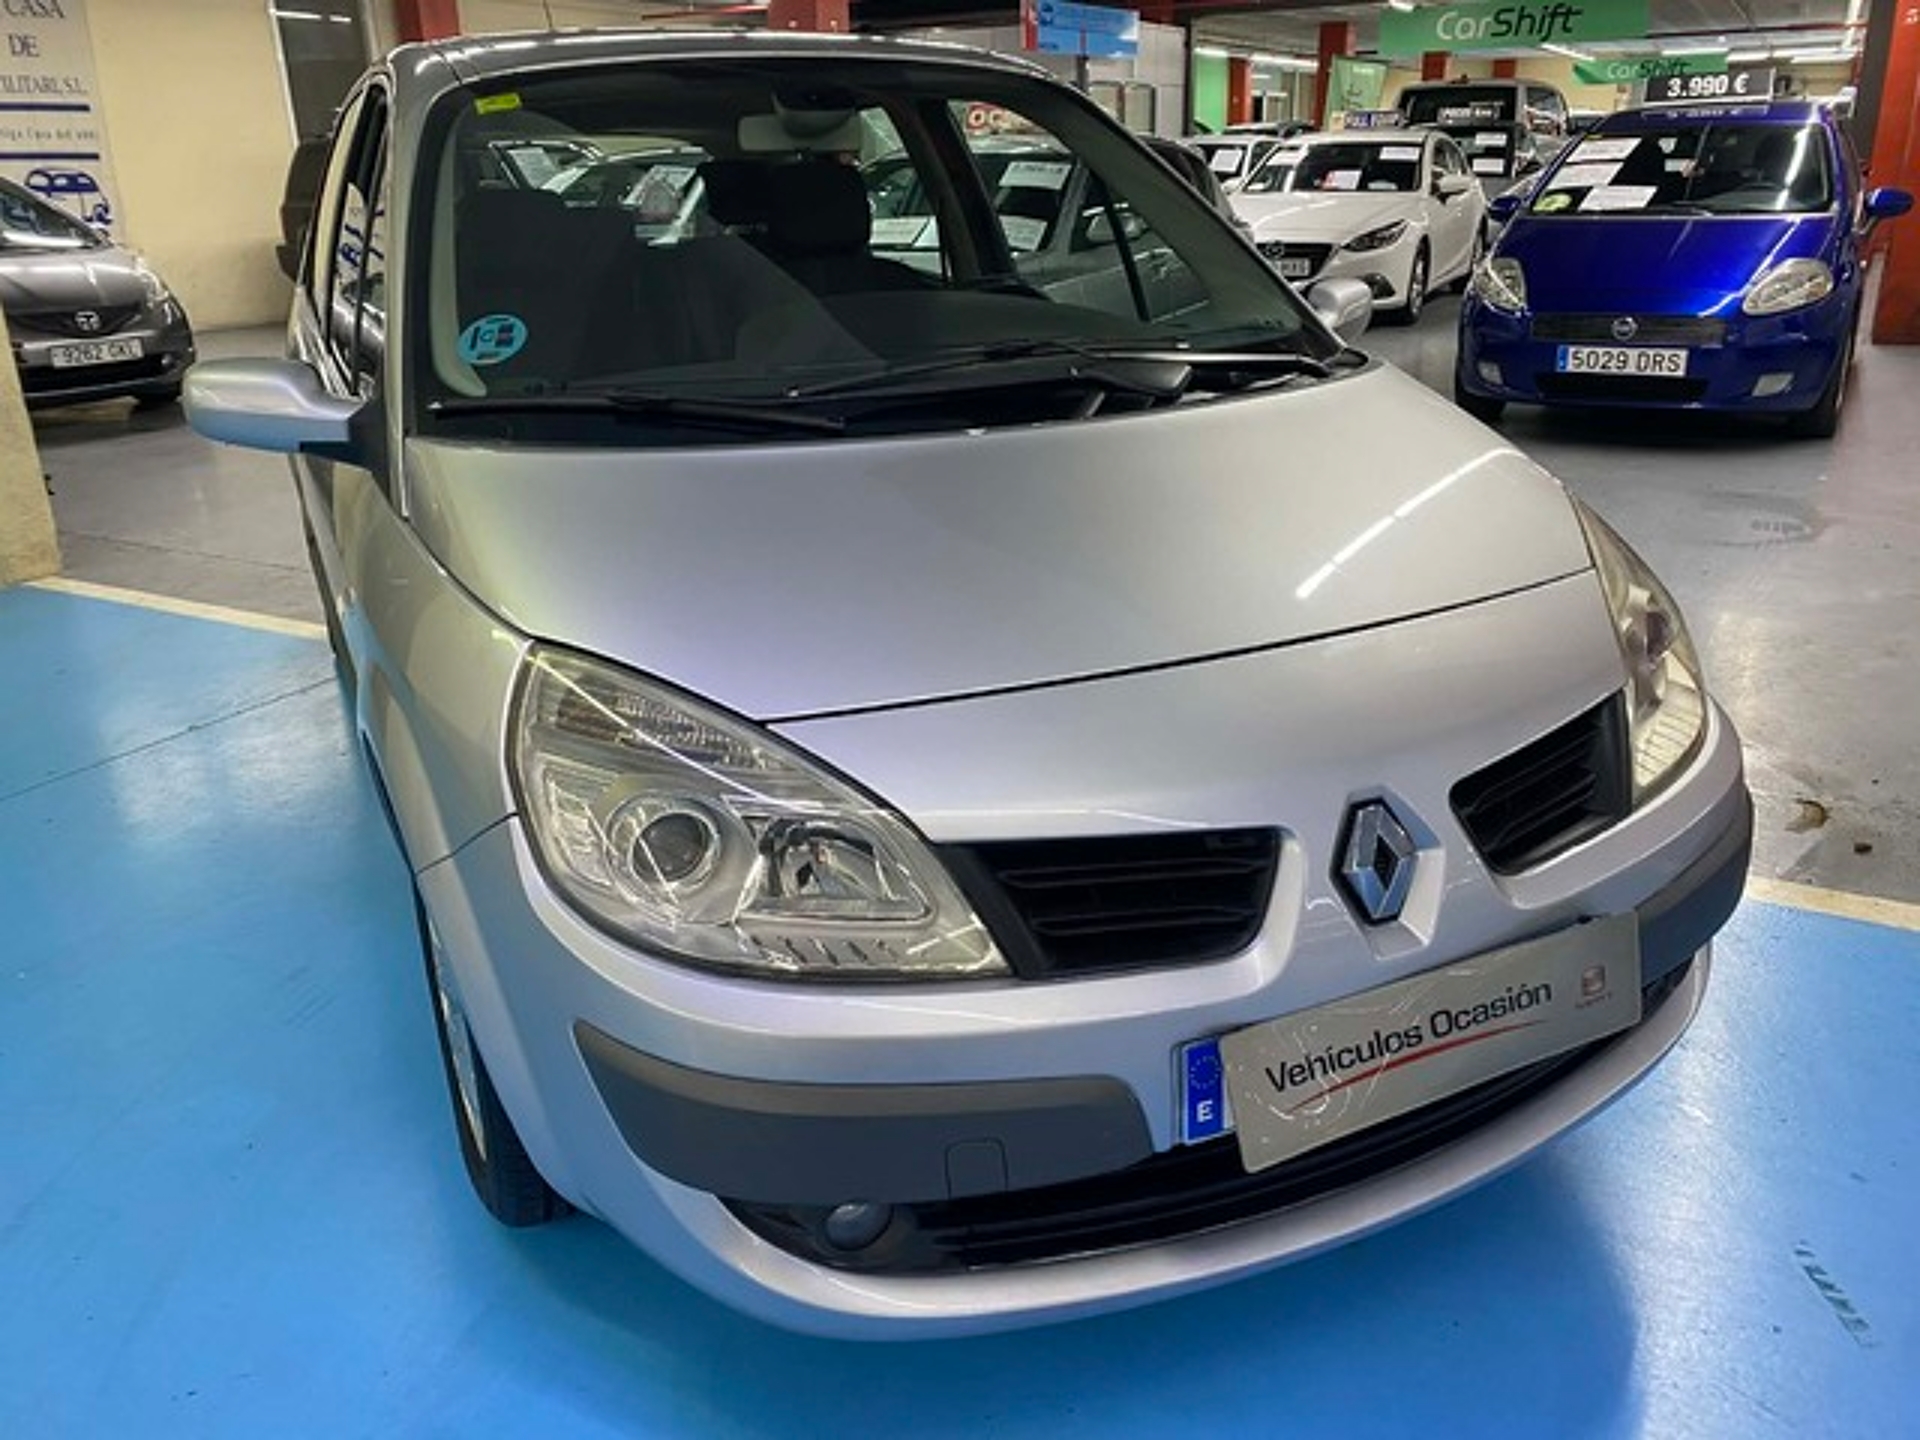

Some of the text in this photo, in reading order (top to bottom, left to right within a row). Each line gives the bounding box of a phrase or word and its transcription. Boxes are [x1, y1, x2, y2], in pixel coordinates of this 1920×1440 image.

[1436, 3, 1584, 42] CarShift
[8, 33, 40, 57] DE
[1666, 71, 1750, 98] 3.990 €
[1571, 349, 1682, 373] 5029 DRS
[1264, 983, 1552, 1092] Vehículos Ocasión
[1196, 1099, 1213, 1123] E
